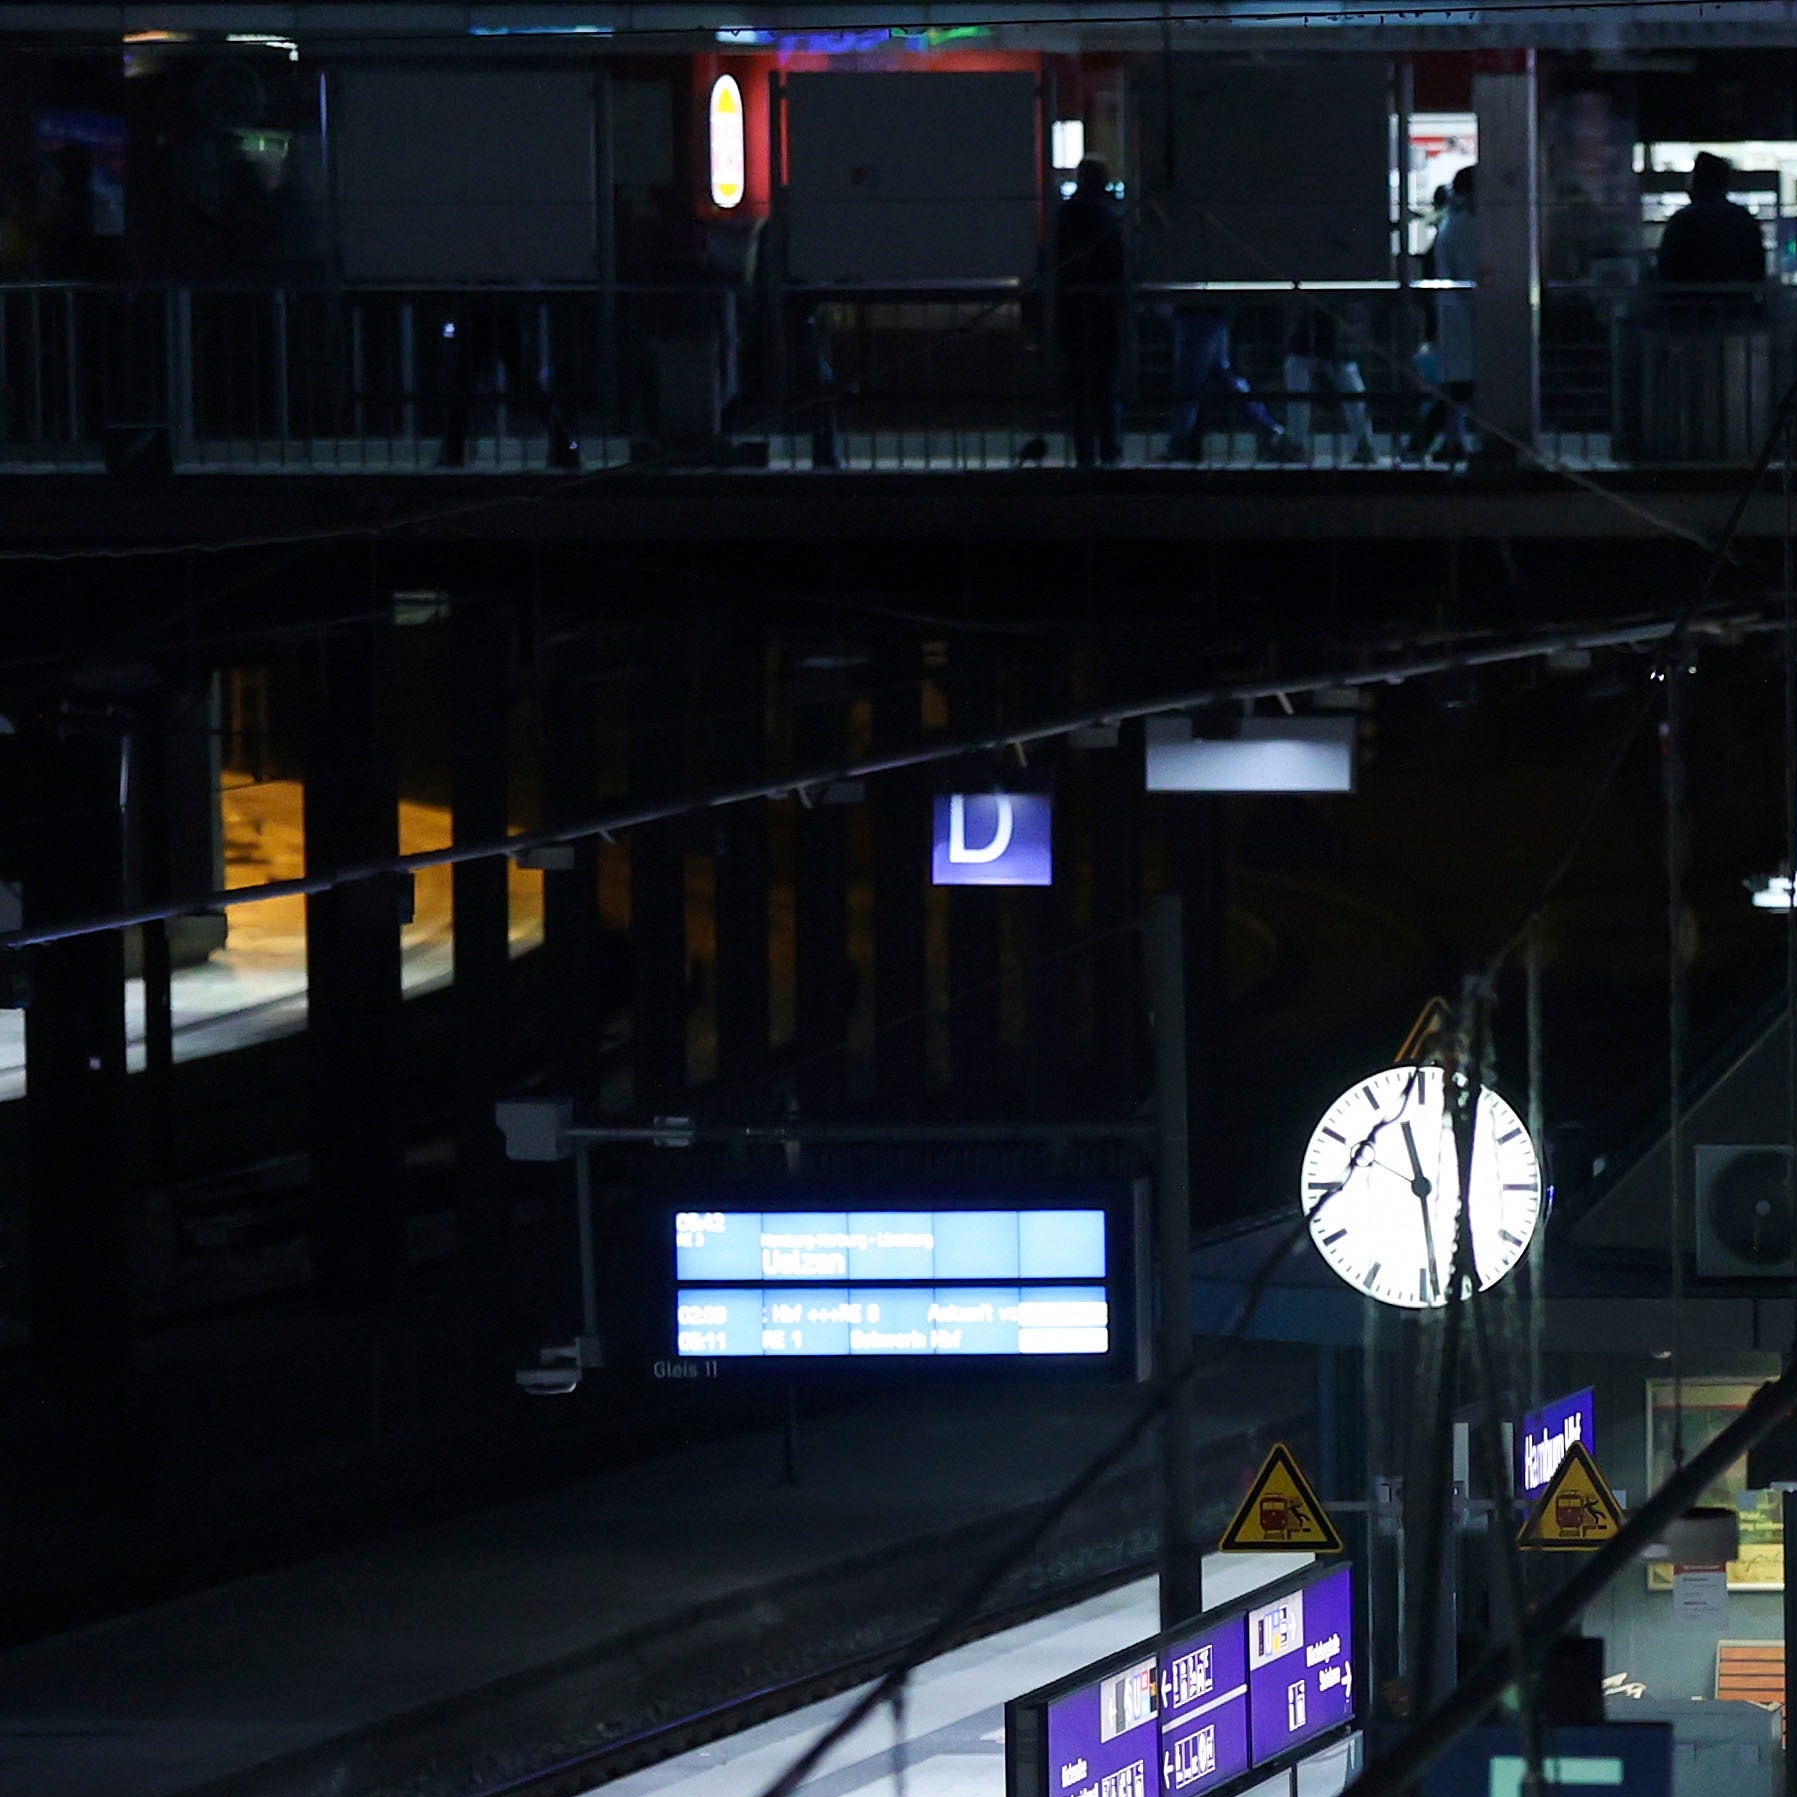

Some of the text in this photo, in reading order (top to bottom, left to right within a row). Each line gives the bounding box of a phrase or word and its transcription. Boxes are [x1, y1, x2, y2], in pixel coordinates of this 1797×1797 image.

[949, 791, 1014, 864] D
[763, 1249, 846, 1275] Uelzen
[653, 1360, 719, 1379] Gleis 11
